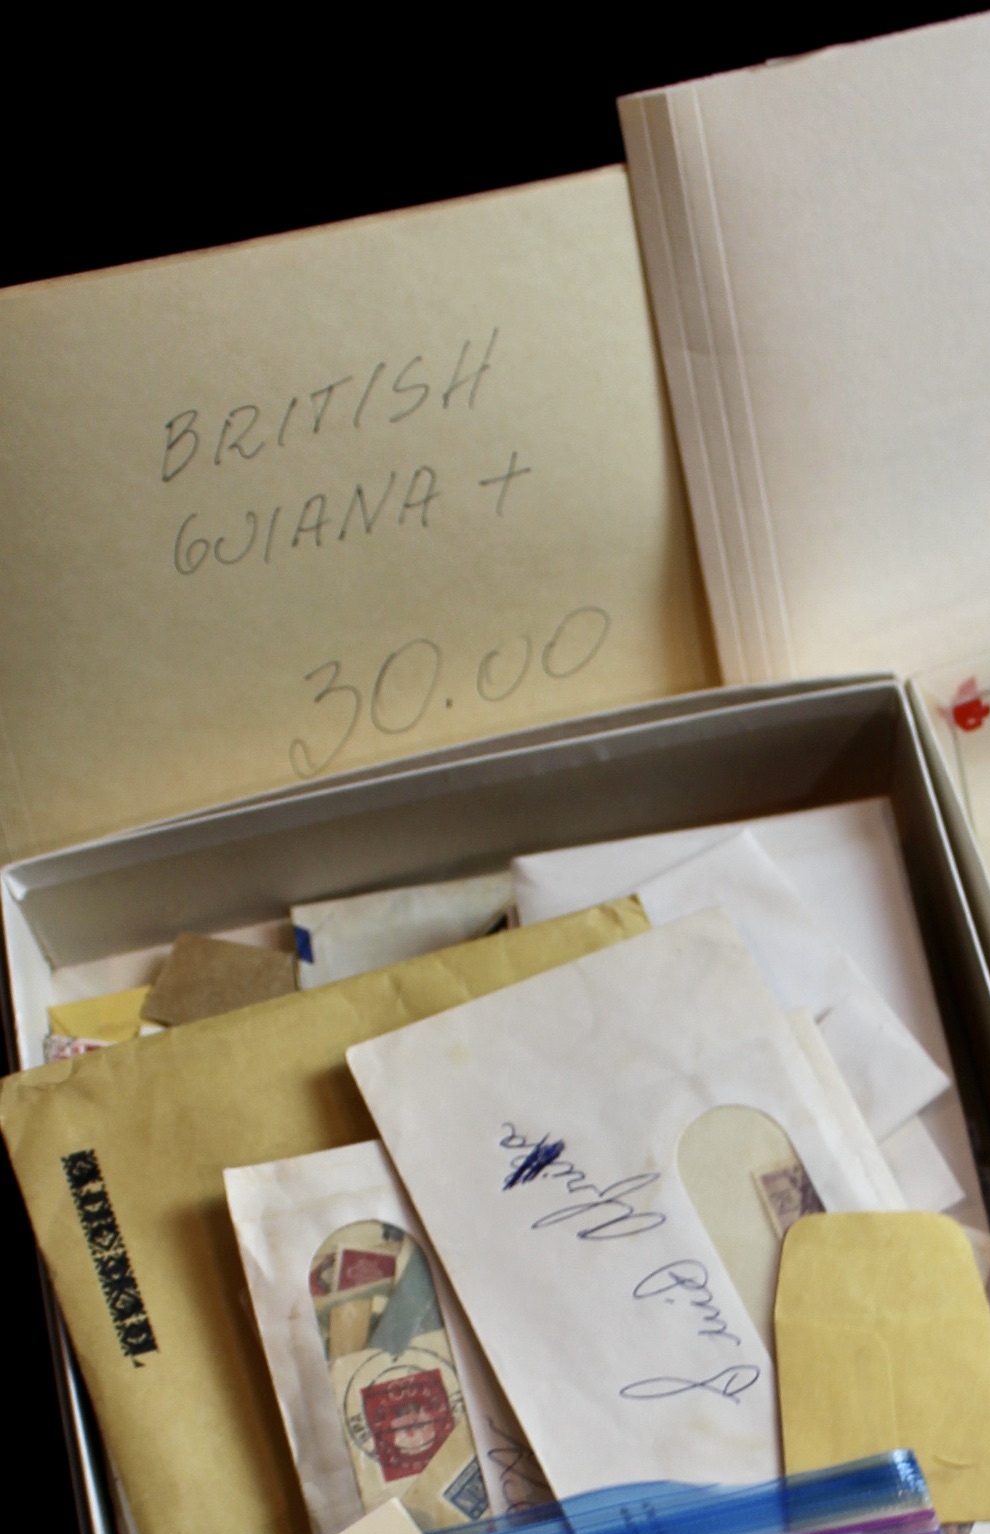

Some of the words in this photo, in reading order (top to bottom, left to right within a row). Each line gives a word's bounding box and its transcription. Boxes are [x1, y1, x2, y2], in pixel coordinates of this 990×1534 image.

[161, 326, 499, 483] BRITISH
[173, 465, 441, 576] GUIANA
[479, 451, 531, 518] +
[289, 605, 612, 778] 30.00
[499, 1121, 667, 1241] Afria
